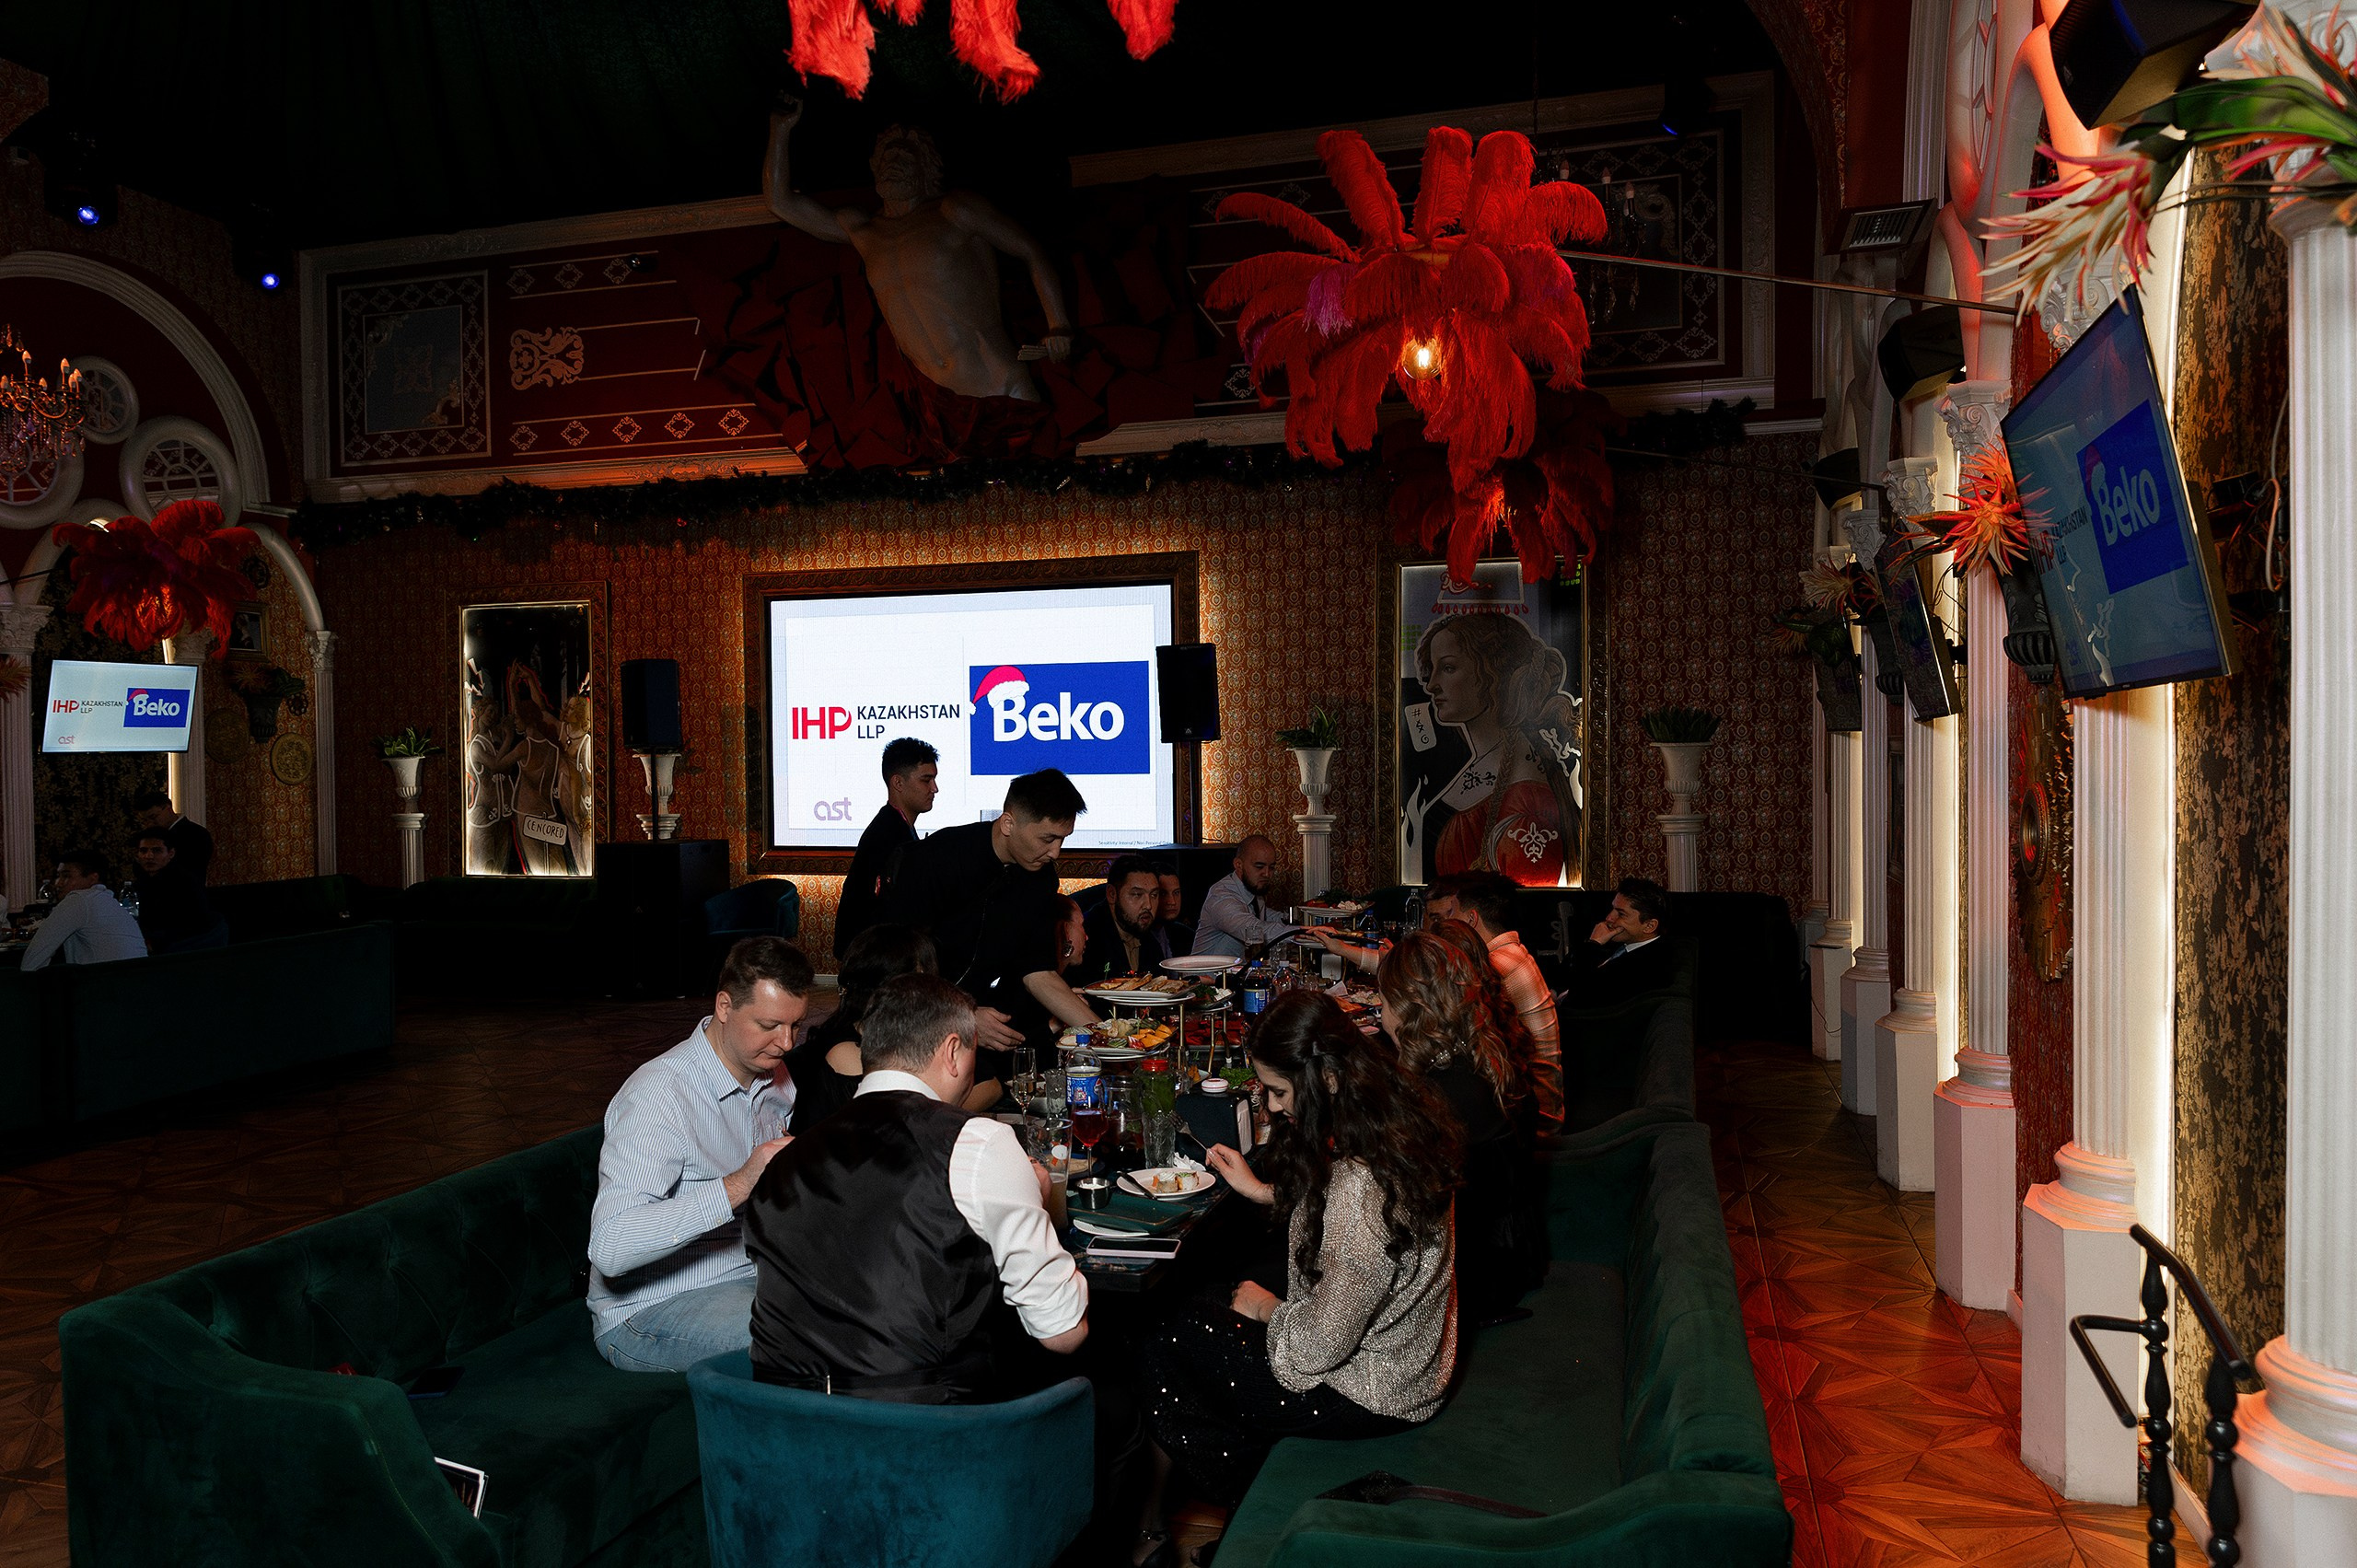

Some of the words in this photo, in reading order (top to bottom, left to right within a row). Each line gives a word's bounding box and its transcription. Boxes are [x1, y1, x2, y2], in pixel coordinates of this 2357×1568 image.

[2096, 465, 2161, 547] Beko
[52, 700, 79, 714] IHP
[134, 698, 180, 716] Beko
[857, 704, 960, 720] KAZAKHSTAN
[792, 706, 853, 739] IHP
[993, 691, 1125, 742] Beko
[58, 735, 75, 745] ast
[857, 725, 886, 739] LLP
[813, 796, 853, 821] ast
